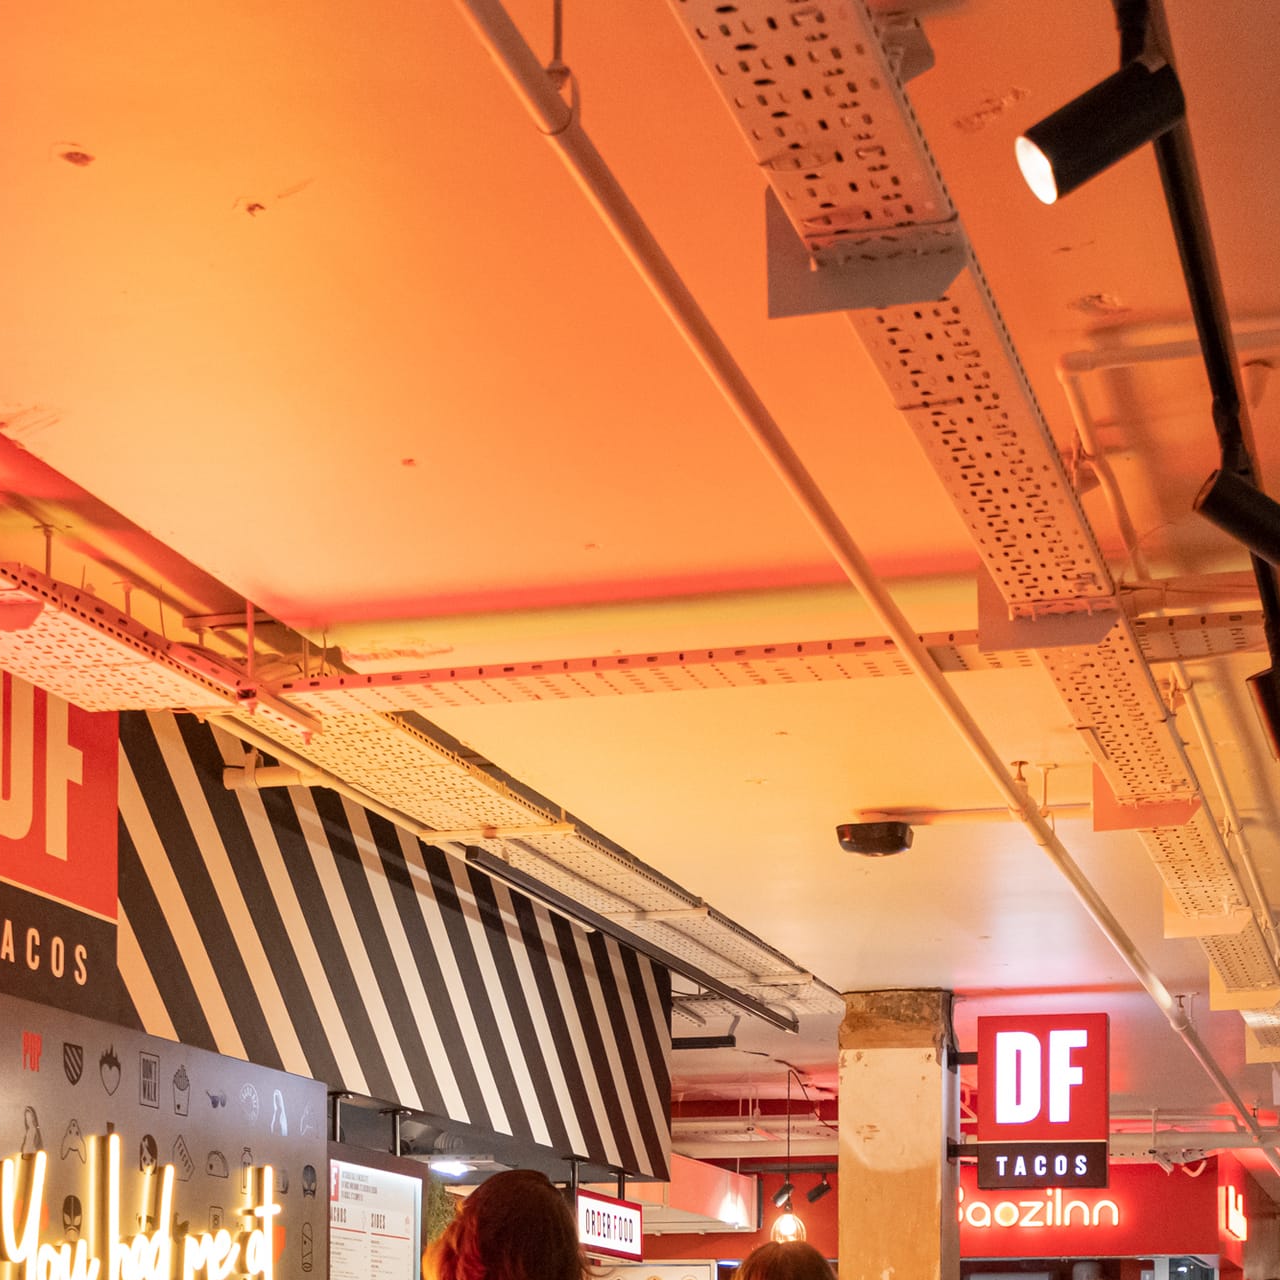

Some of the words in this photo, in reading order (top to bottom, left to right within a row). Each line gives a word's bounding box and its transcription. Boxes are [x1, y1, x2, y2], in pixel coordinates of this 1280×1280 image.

[995, 1029, 1088, 1124] DF
[996, 1155, 1088, 1177] TACOS
[370, 1213, 386, 1230] SIDES
[585, 1208, 612, 1240] ORDER
[614, 1214, 634, 1244] FOOD
